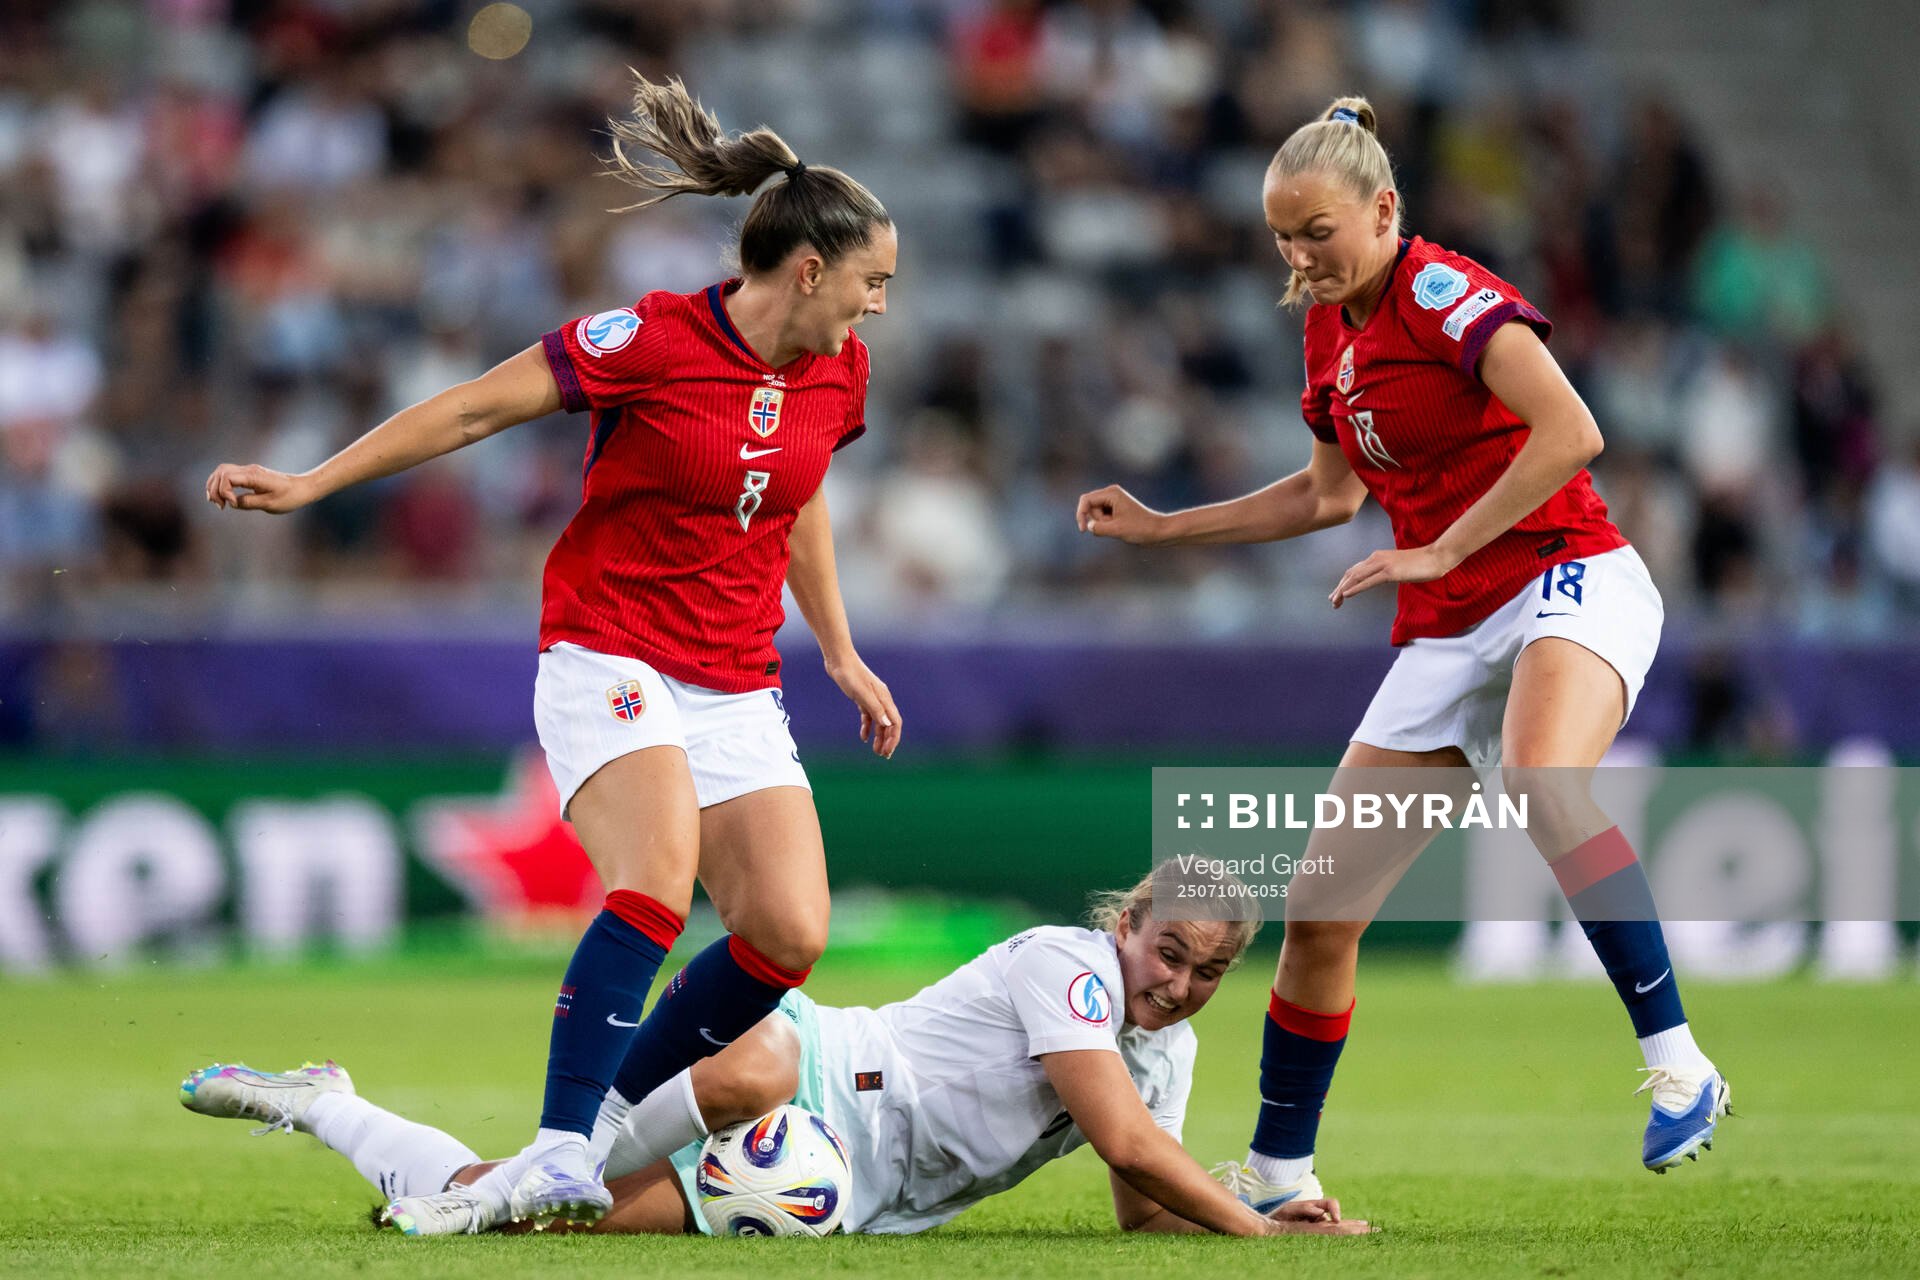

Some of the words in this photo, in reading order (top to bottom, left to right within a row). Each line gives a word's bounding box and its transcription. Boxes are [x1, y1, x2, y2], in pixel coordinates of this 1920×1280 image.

[1347, 410, 1402, 472] 18
[733, 470, 771, 533] 8
[1542, 561, 1586, 607] 18
